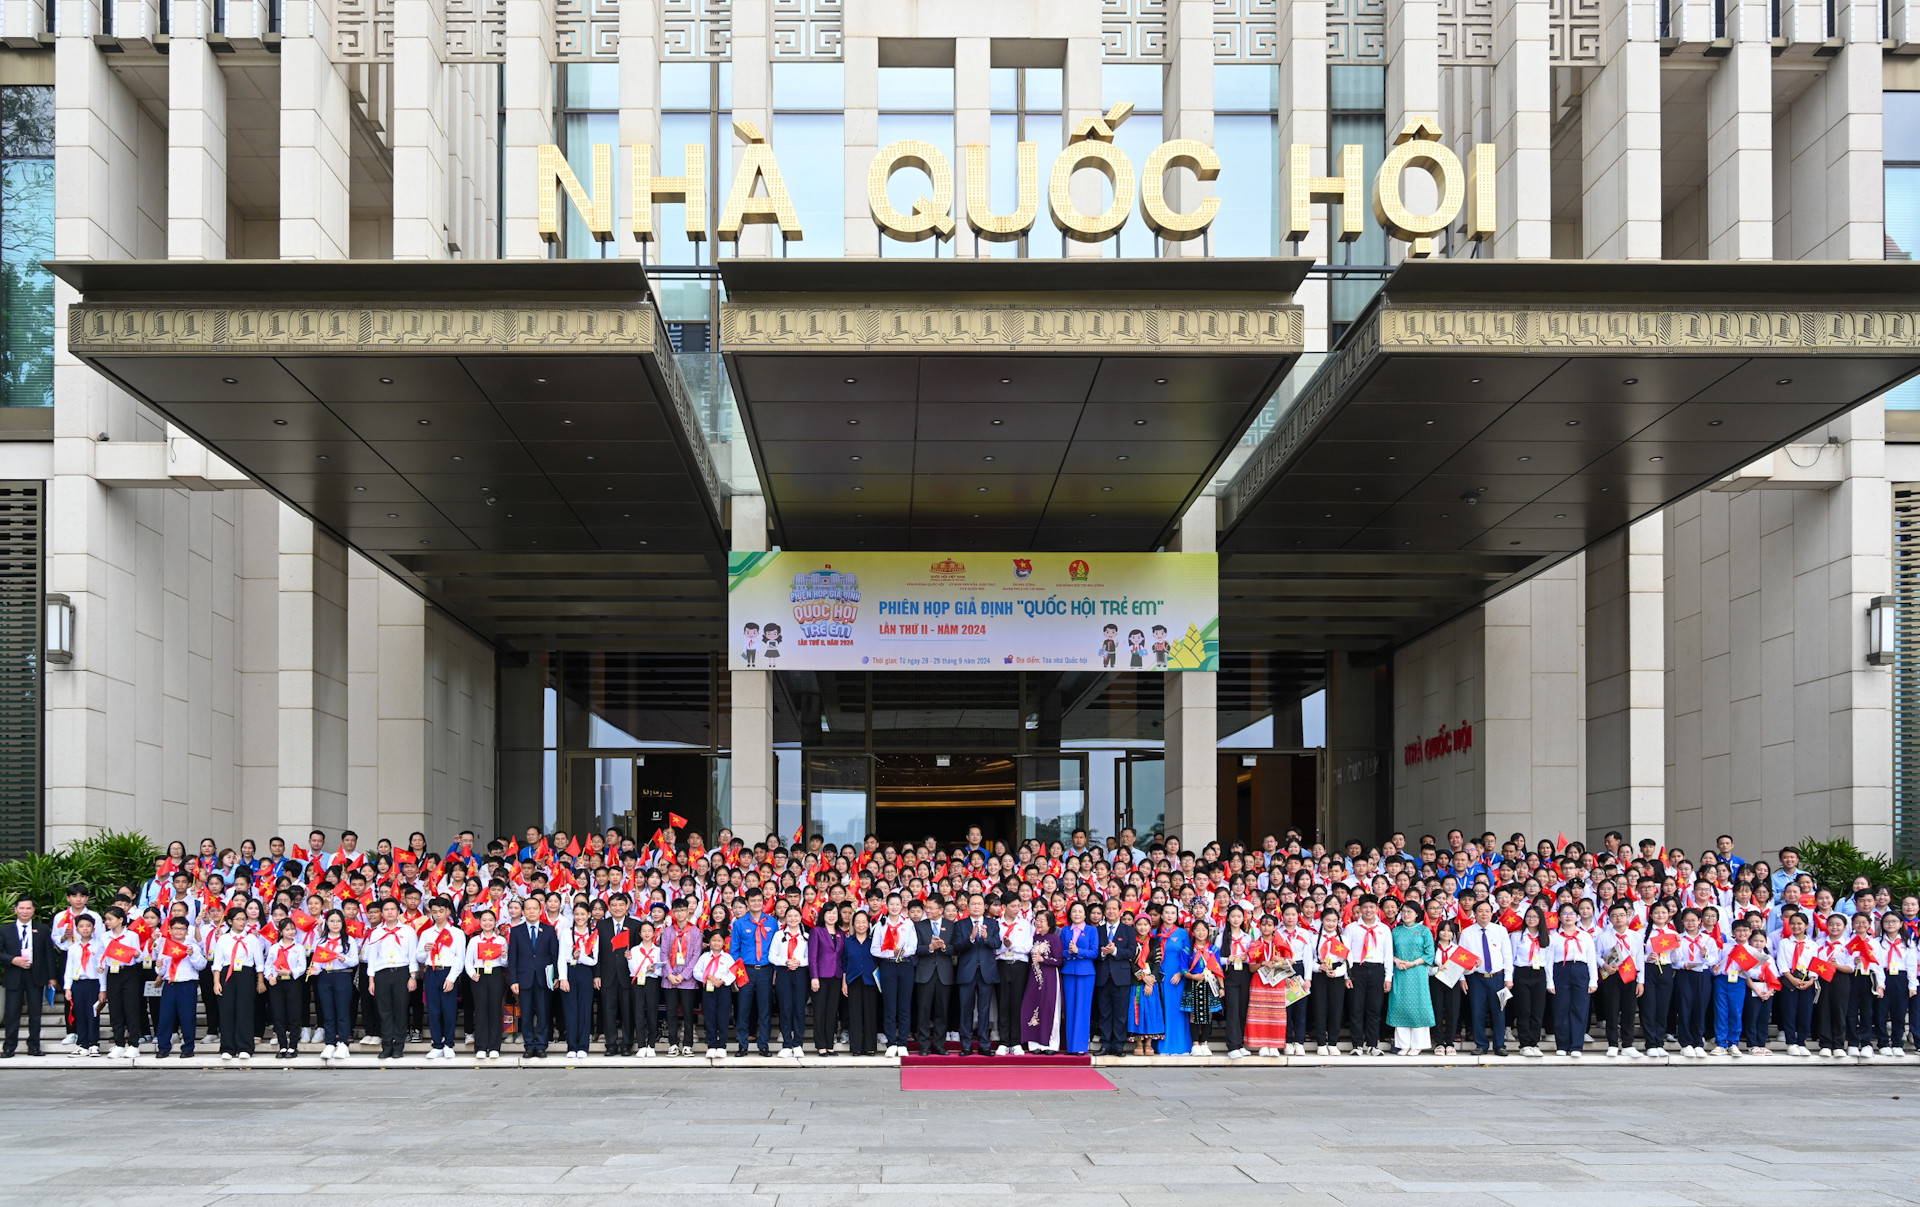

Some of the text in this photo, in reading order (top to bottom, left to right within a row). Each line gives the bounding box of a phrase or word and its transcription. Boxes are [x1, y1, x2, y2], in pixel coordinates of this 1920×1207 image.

[537, 102, 1496, 259] NHÀ QUỐC HỘI
[793, 599, 858, 624] QUỐC HỘI
[879, 598, 919, 615] PHIÊN
[924, 601, 950, 618] HỌP
[955, 596, 977, 615] GIẢ
[981, 601, 1013, 618] ĐỊNH
[1017, 594, 1067, 618] "QUỐC
[1071, 597, 1096, 618] HỘI
[1100, 596, 1128, 615] TRẺ
[800, 620, 827, 638] TRẺ
[879, 621, 896, 635] LẦN
[899, 623, 919, 635] THỨ
[921, 625, 928, 635] II
[937, 624, 959, 635] NĂM
[961, 625, 986, 635] 2024
